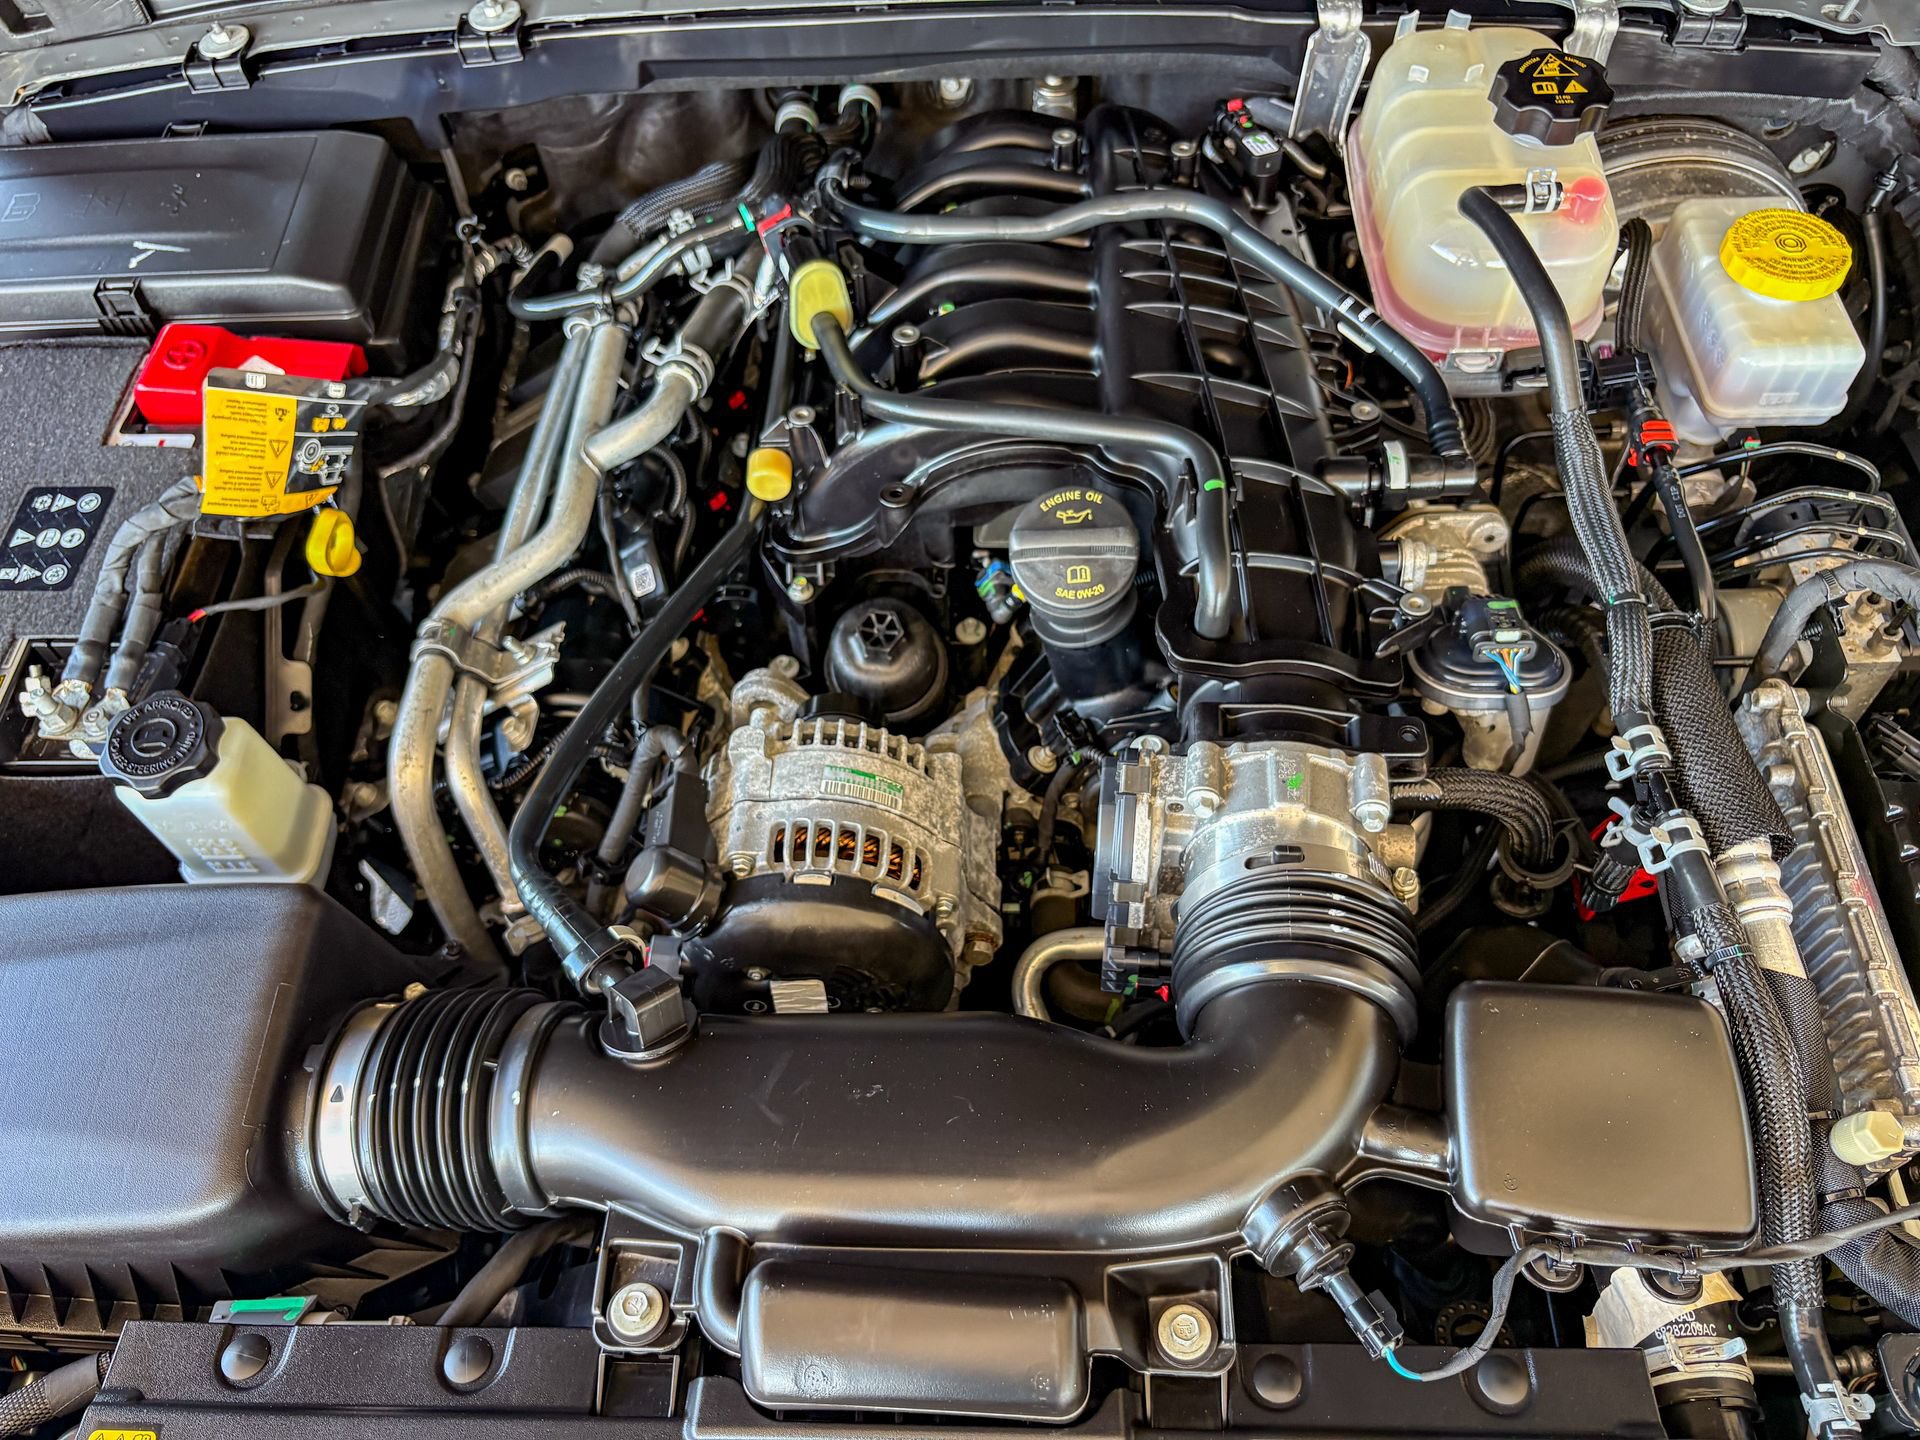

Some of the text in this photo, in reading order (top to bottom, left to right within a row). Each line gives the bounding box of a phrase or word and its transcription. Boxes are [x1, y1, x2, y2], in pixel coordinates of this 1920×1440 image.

[1040, 490, 1104, 512] ENGINE OIL
[1055, 584, 1105, 599] SAE 0W-20
[144, 698, 193, 719] APPROVED
[126, 755, 176, 775] STEERING
[175, 730, 196, 758] FLUID
[1655, 1321, 1717, 1341] 68282209AC
